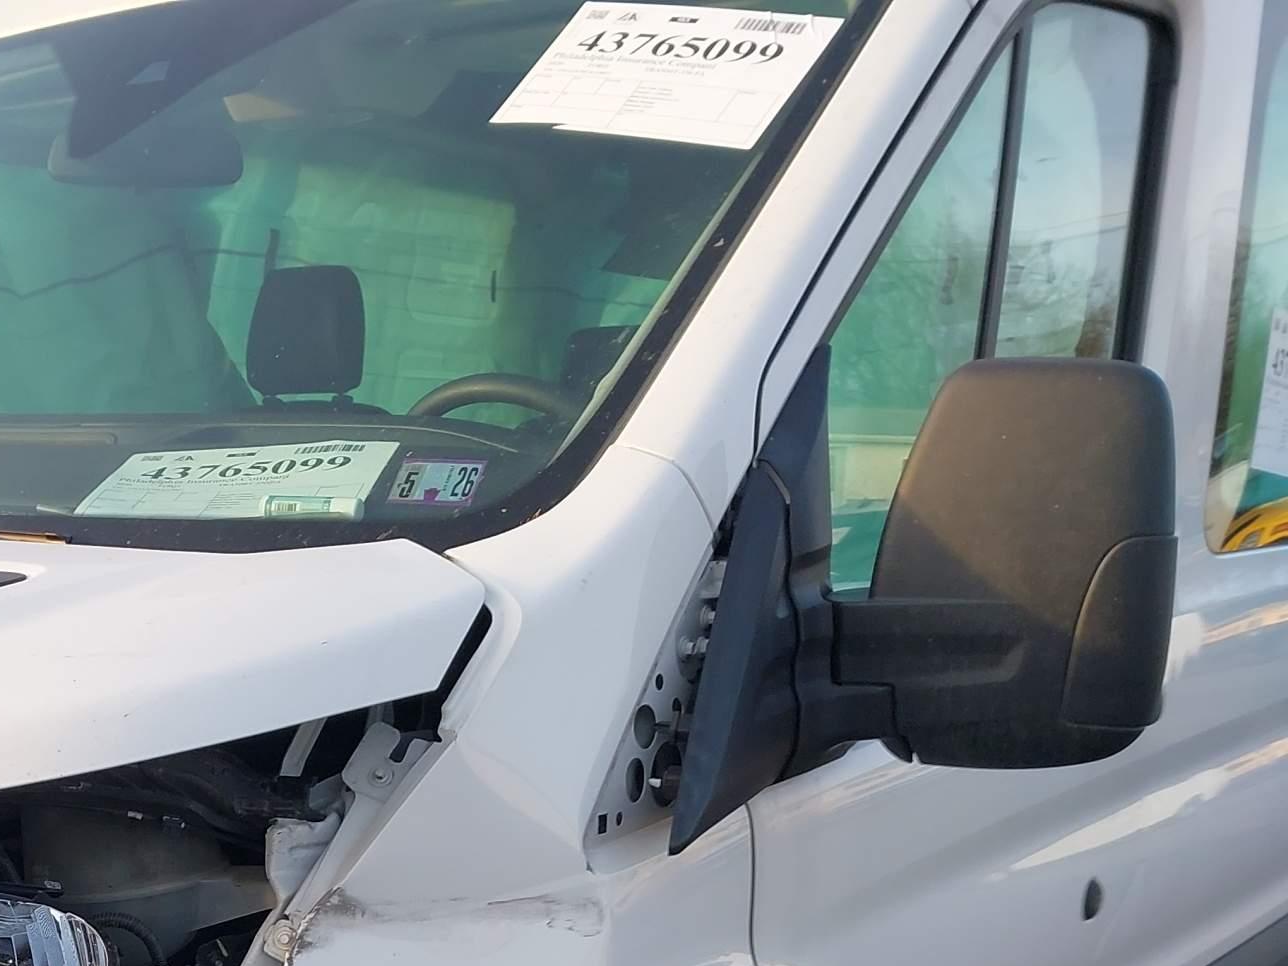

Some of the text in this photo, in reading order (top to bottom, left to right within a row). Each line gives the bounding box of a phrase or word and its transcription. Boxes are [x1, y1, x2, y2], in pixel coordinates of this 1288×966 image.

[578, 30, 784, 65] 43765099
[141, 455, 352, 480] 43765099
[450, 466, 479, 497] 26
